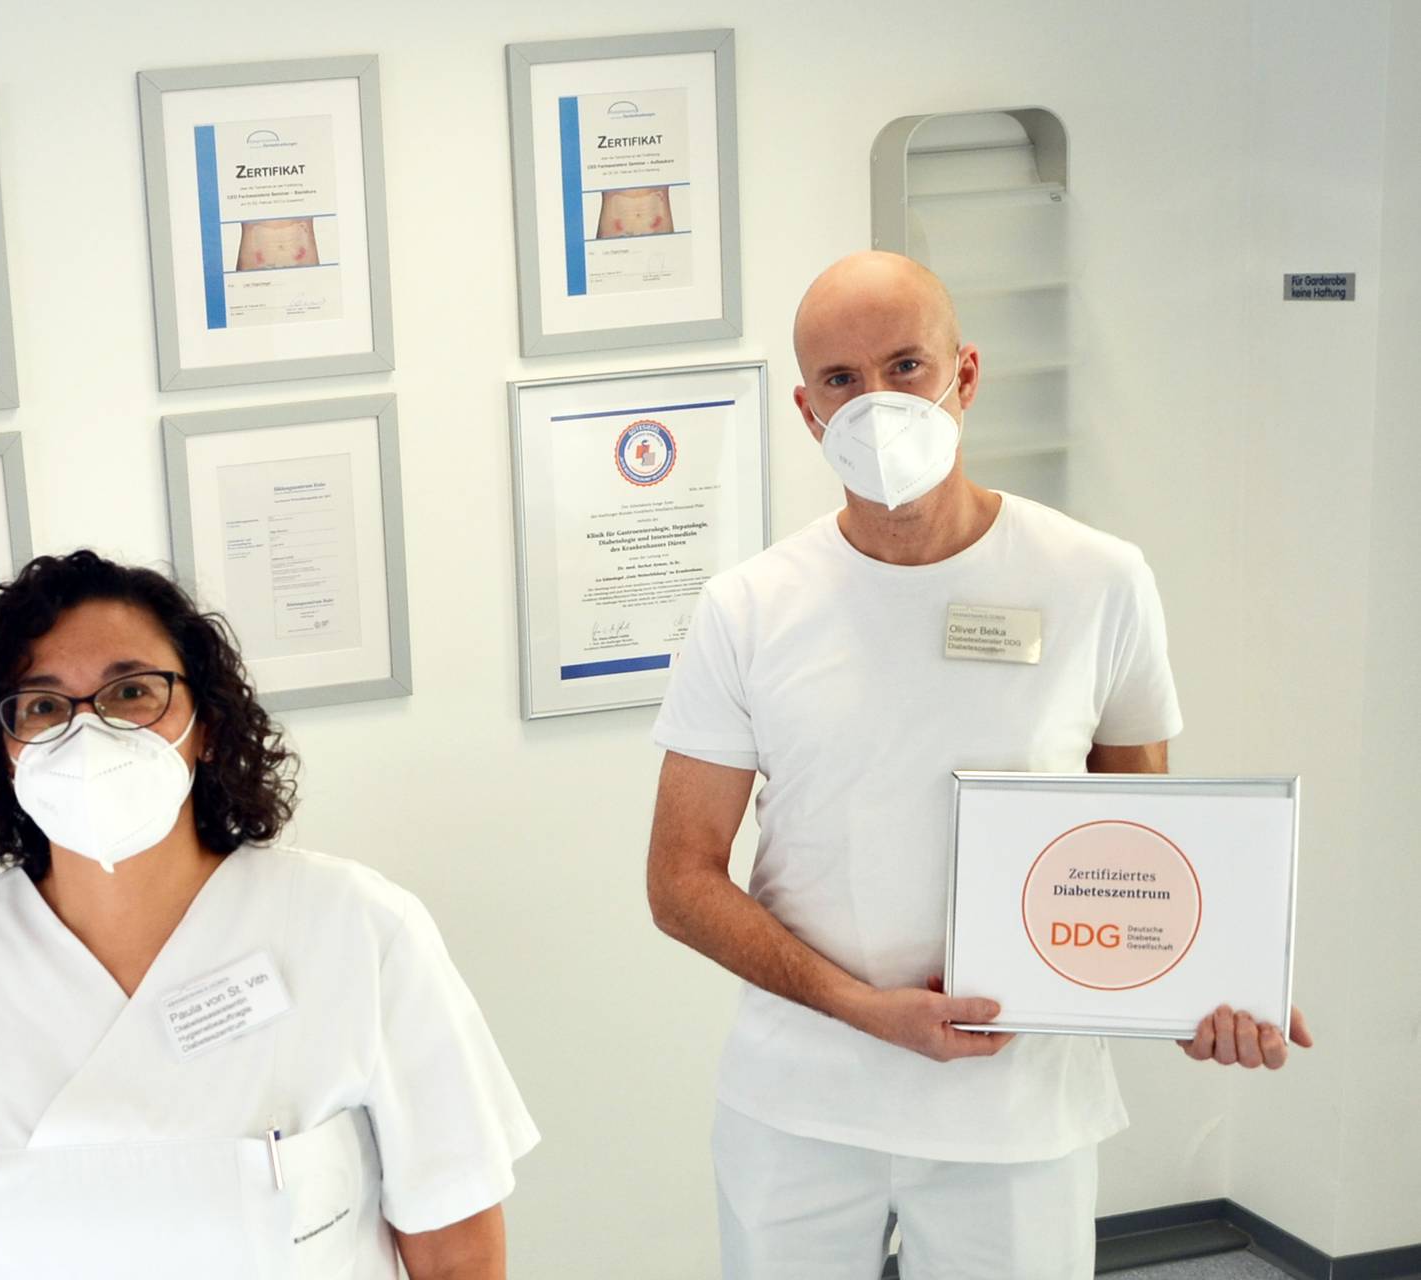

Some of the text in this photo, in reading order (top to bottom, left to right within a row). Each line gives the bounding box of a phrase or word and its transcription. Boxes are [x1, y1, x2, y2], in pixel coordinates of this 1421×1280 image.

[597, 134, 663, 149] ZERTIFIKAT
[235, 163, 306, 180] ZERTIFIKAT
[1304, 275, 1347, 286] Garderobe
[1313, 287, 1347, 301] Haftung
[948, 623, 977, 634] Oliver
[1004, 639, 1021, 647] DDG
[1068, 867, 1157, 883] Zertifiziertes
[1053, 884, 1172, 901] Diabeteszentrum
[1050, 922, 1123, 950] DDG
[1127, 925, 1164, 935] Deutsche
[1127, 933, 1161, 942] Diabetes
[1126, 942, 1174, 952] Gesellschaft
[169, 1004, 203, 1023] Paula
[204, 993, 226, 1007] von
